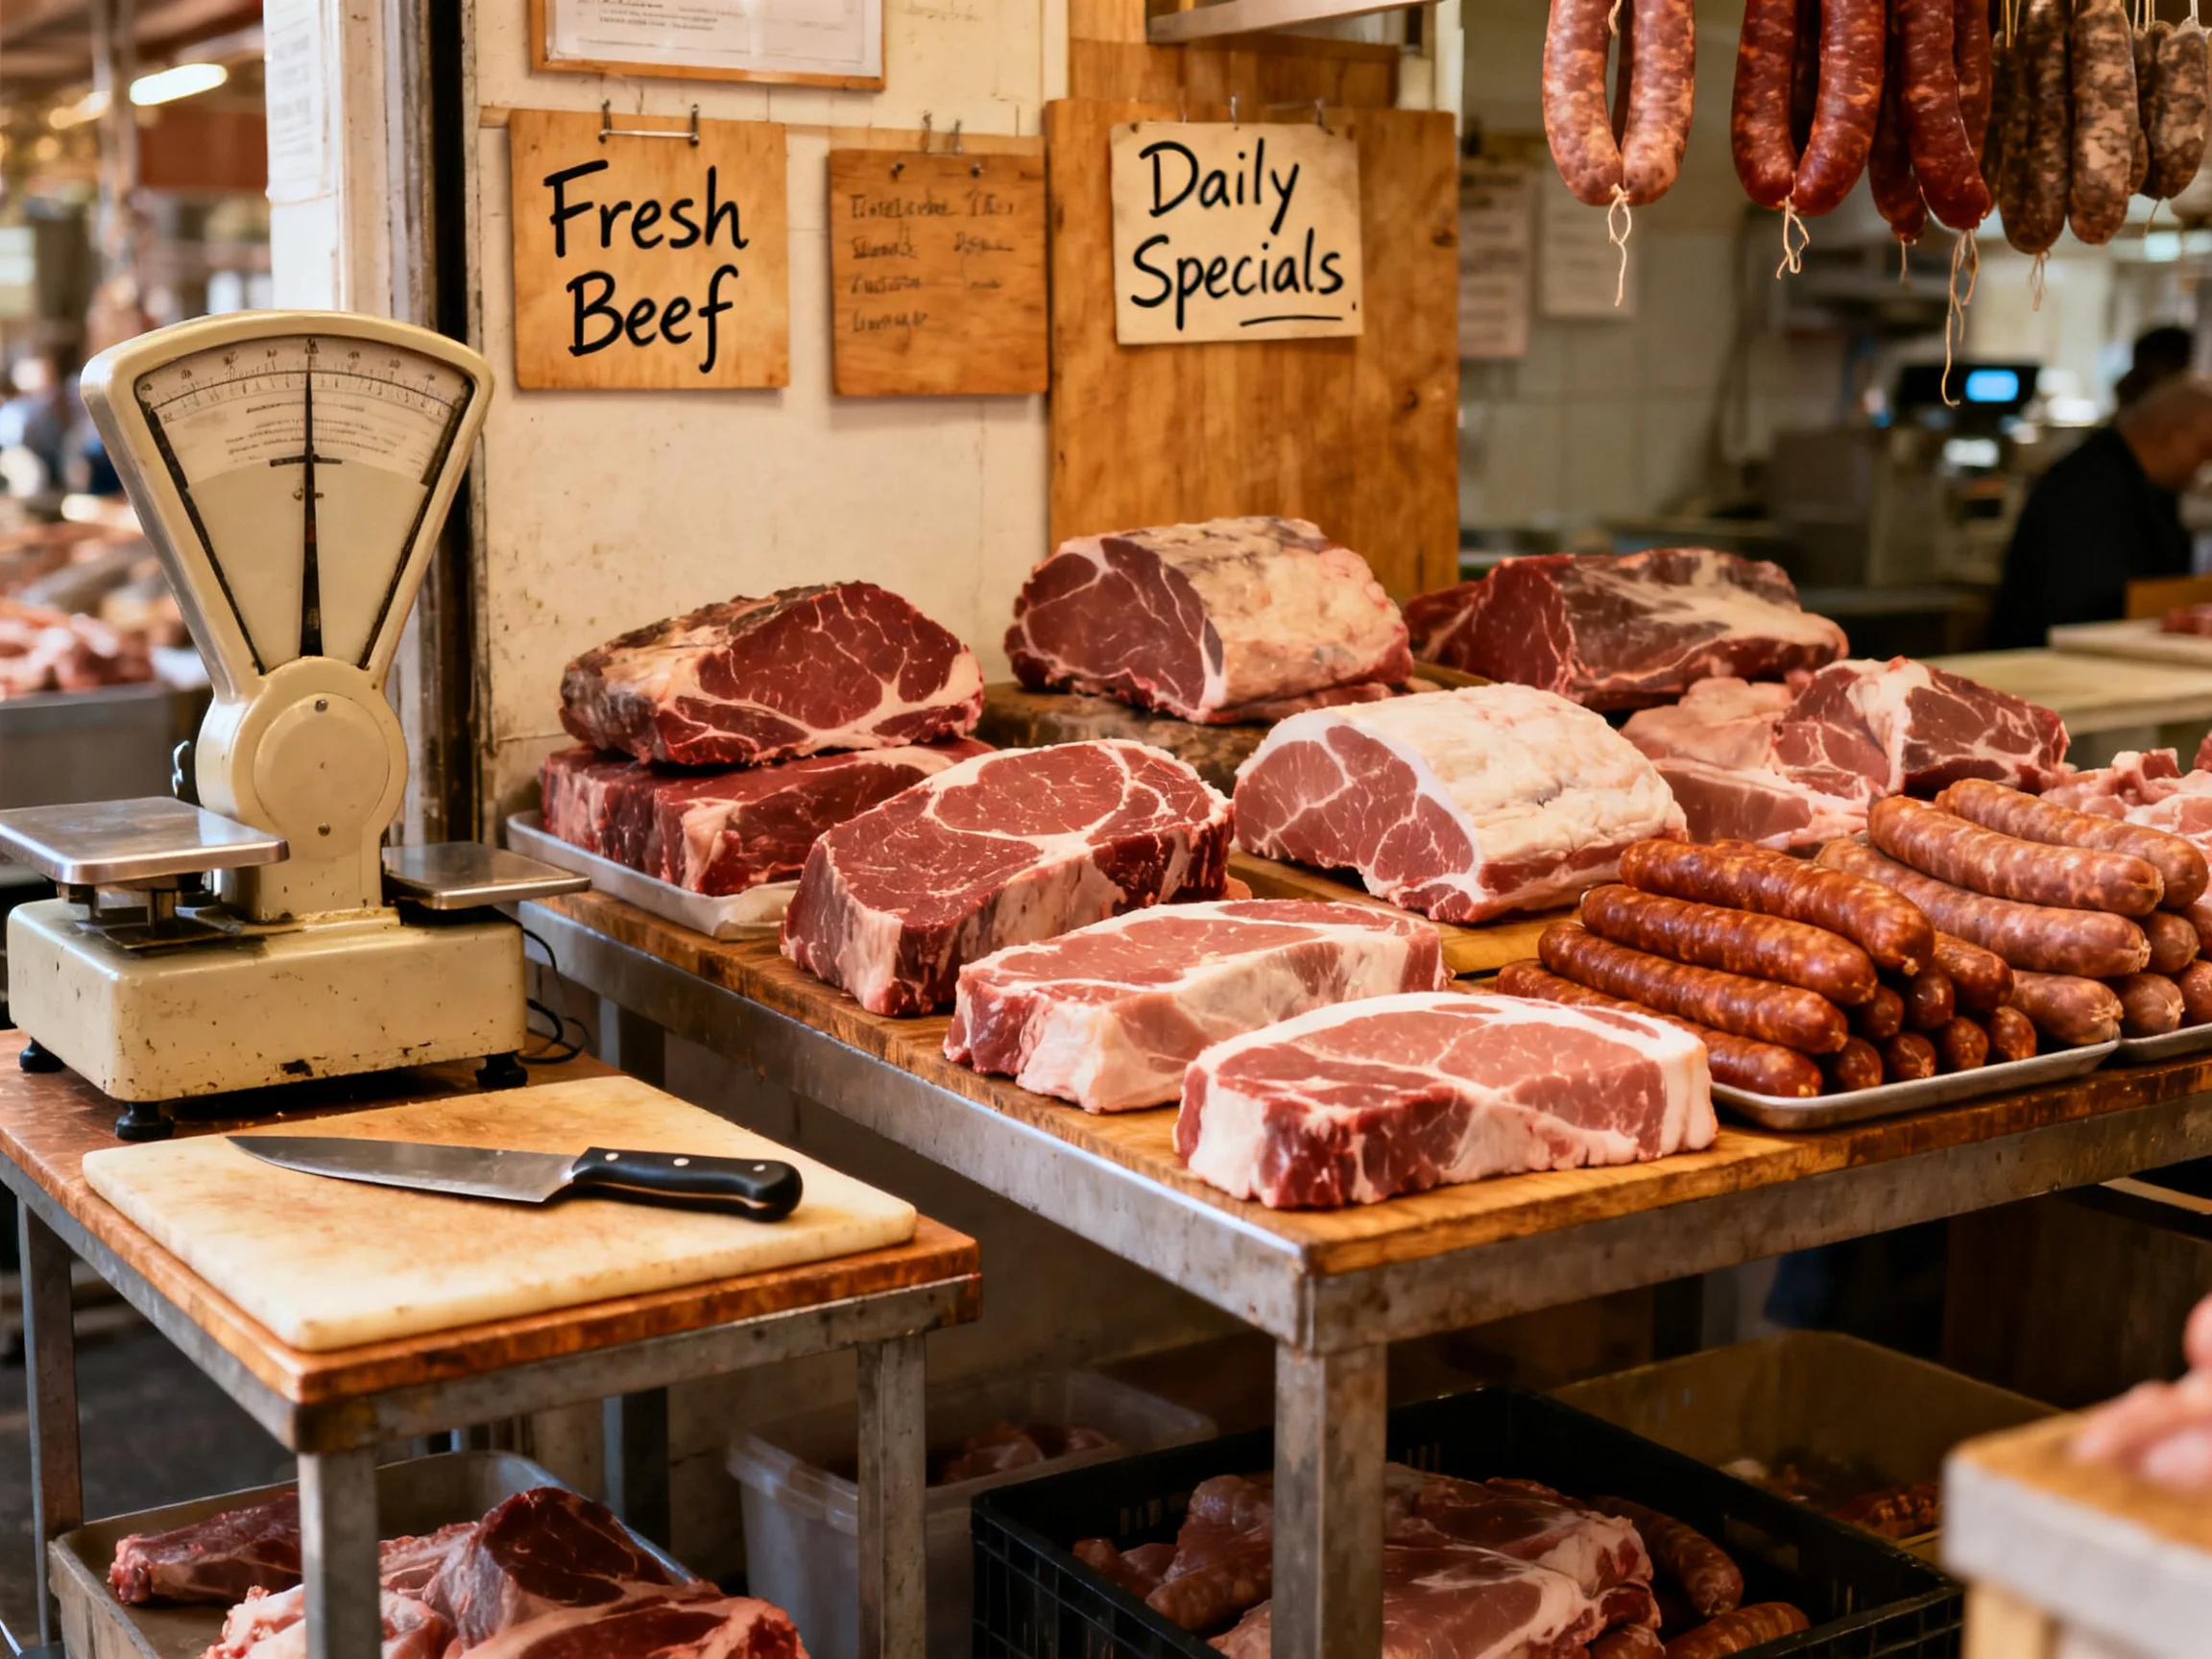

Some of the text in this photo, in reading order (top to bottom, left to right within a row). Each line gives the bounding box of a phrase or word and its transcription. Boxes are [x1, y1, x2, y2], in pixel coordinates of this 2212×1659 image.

[542, 159, 750, 258] Fresh
[1139, 137, 1300, 236] Daily
[565, 264, 739, 374] Beef
[1130, 227, 1344, 331] Specials
